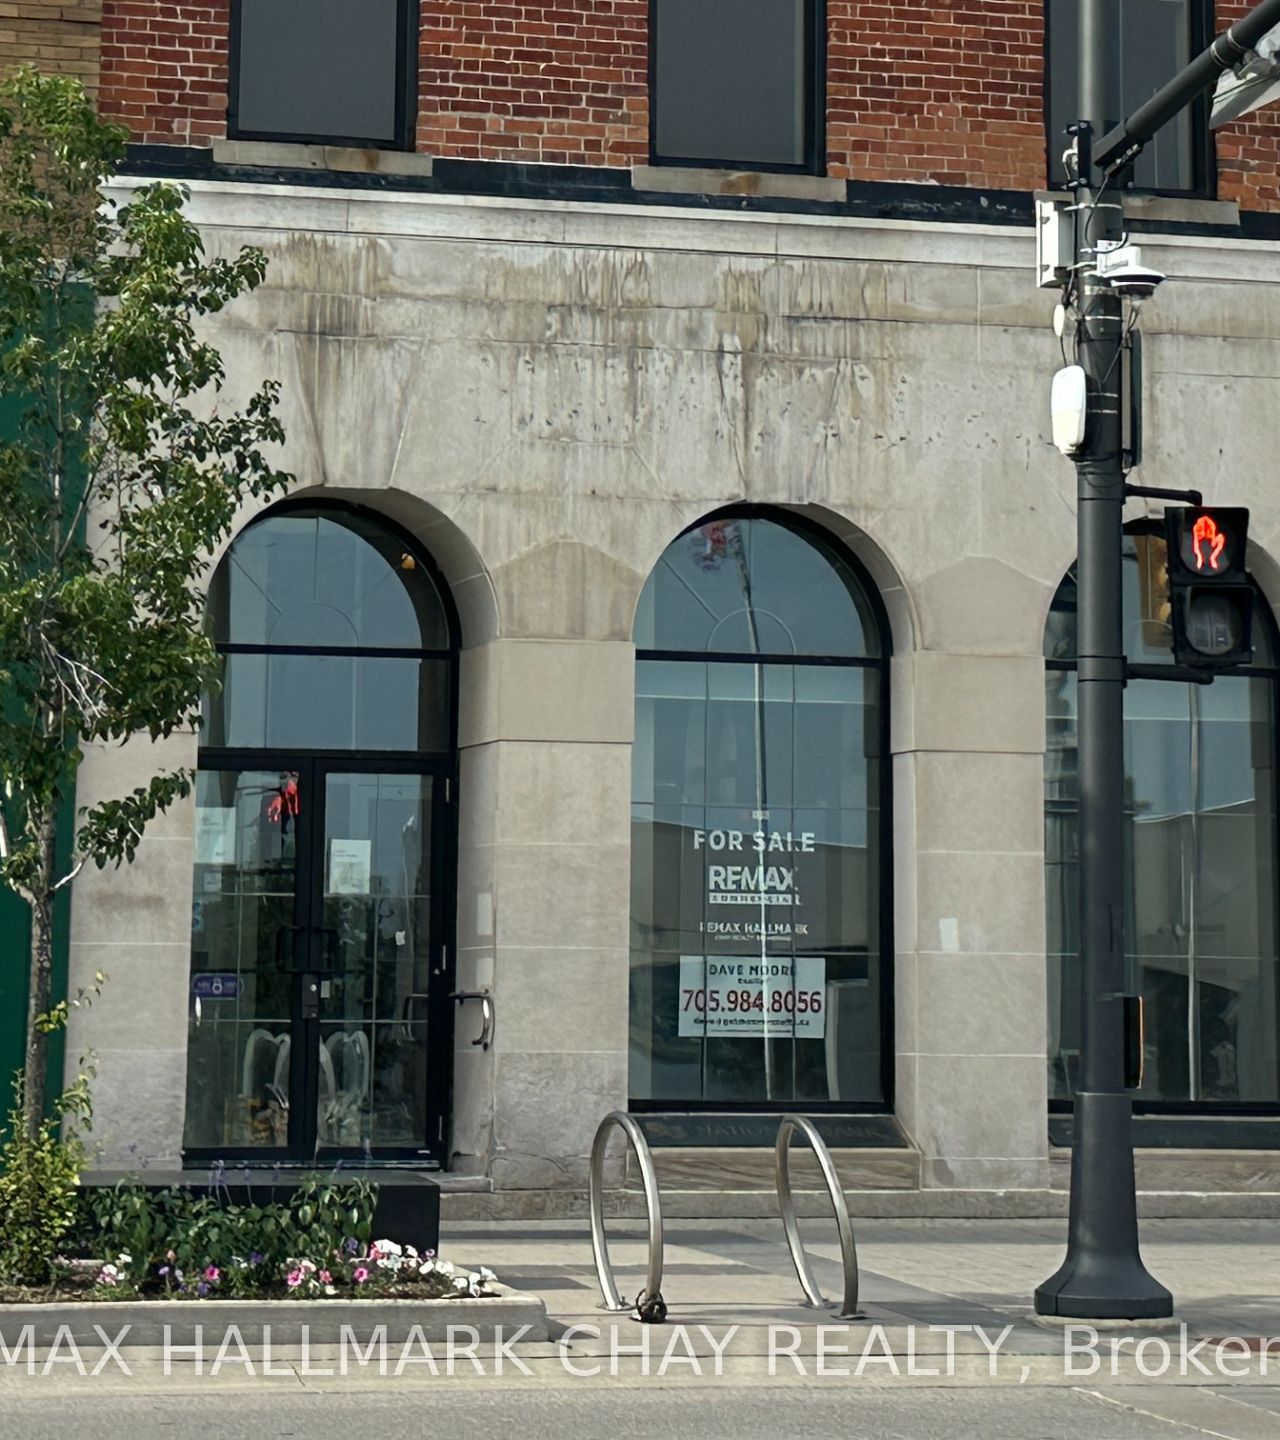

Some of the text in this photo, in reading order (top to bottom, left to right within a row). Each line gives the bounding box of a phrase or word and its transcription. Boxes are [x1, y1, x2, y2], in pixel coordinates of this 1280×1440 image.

[693, 830, 815, 852] FOR SALE
[709, 964, 744, 975] DAVE
[682, 989, 822, 1013] 705.984.8056
